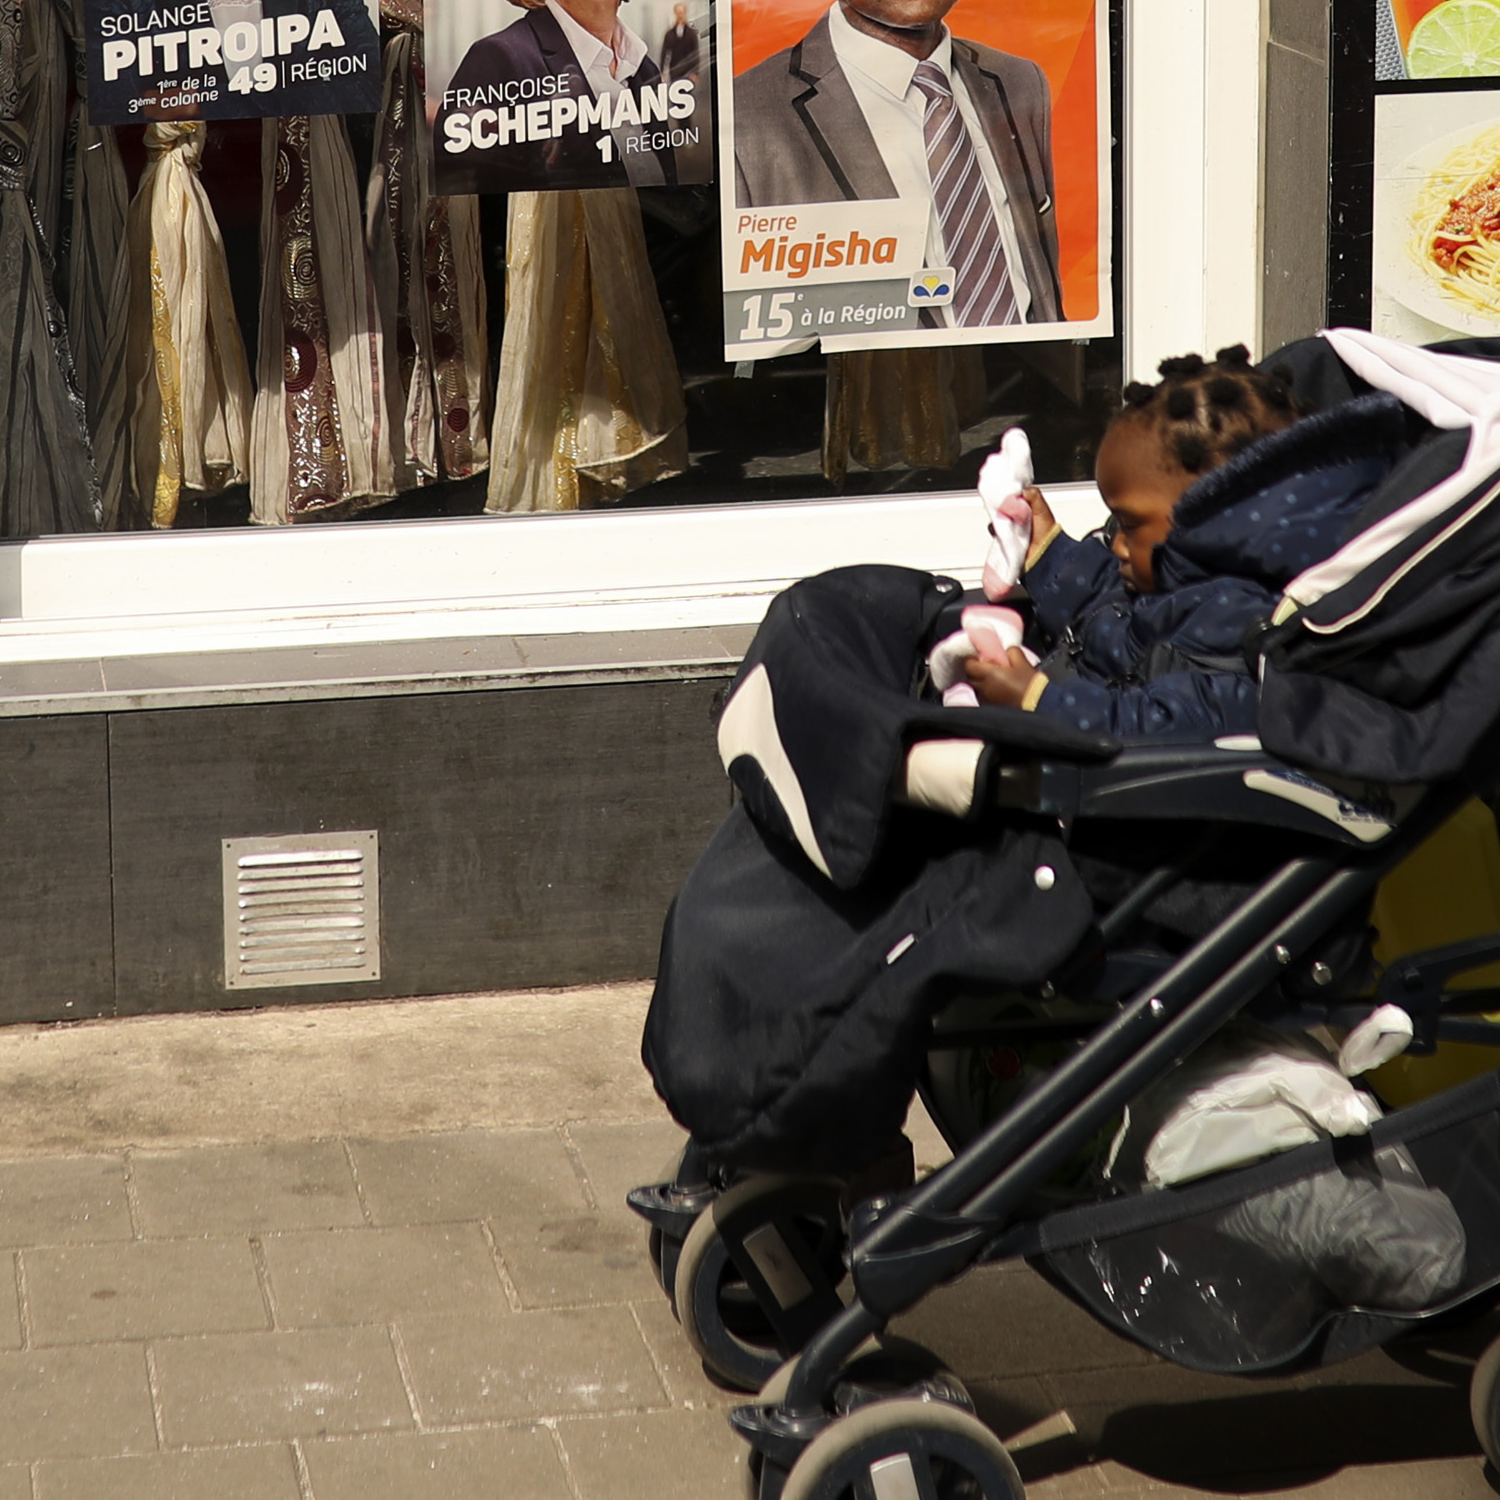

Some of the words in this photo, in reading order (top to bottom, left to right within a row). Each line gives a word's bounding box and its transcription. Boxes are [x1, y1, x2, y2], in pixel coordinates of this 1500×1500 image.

[100, 2, 211, 37] SOLANGE
[102, 8, 346, 82] PITROIPA
[156, 78, 178, 95] 1ère
[181, 75, 200, 92] de
[203, 73, 217, 88] la
[227, 62, 278, 96] 49
[290, 53, 368, 83] RÉGION
[443, 73, 570, 111] FRANÇOISE
[128, 96, 157, 114] 3ème
[160, 88, 219, 109] colonne
[443, 78, 696, 154] SCHEPMANS
[595, 135, 613, 164] 1
[625, 126, 699, 155] RÉGION
[737, 212, 797, 235] Pierre
[740, 230, 898, 279] Migisha
[800, 305, 812, 326] à
[817, 304, 835, 326] la
[839, 300, 906, 326] Région
